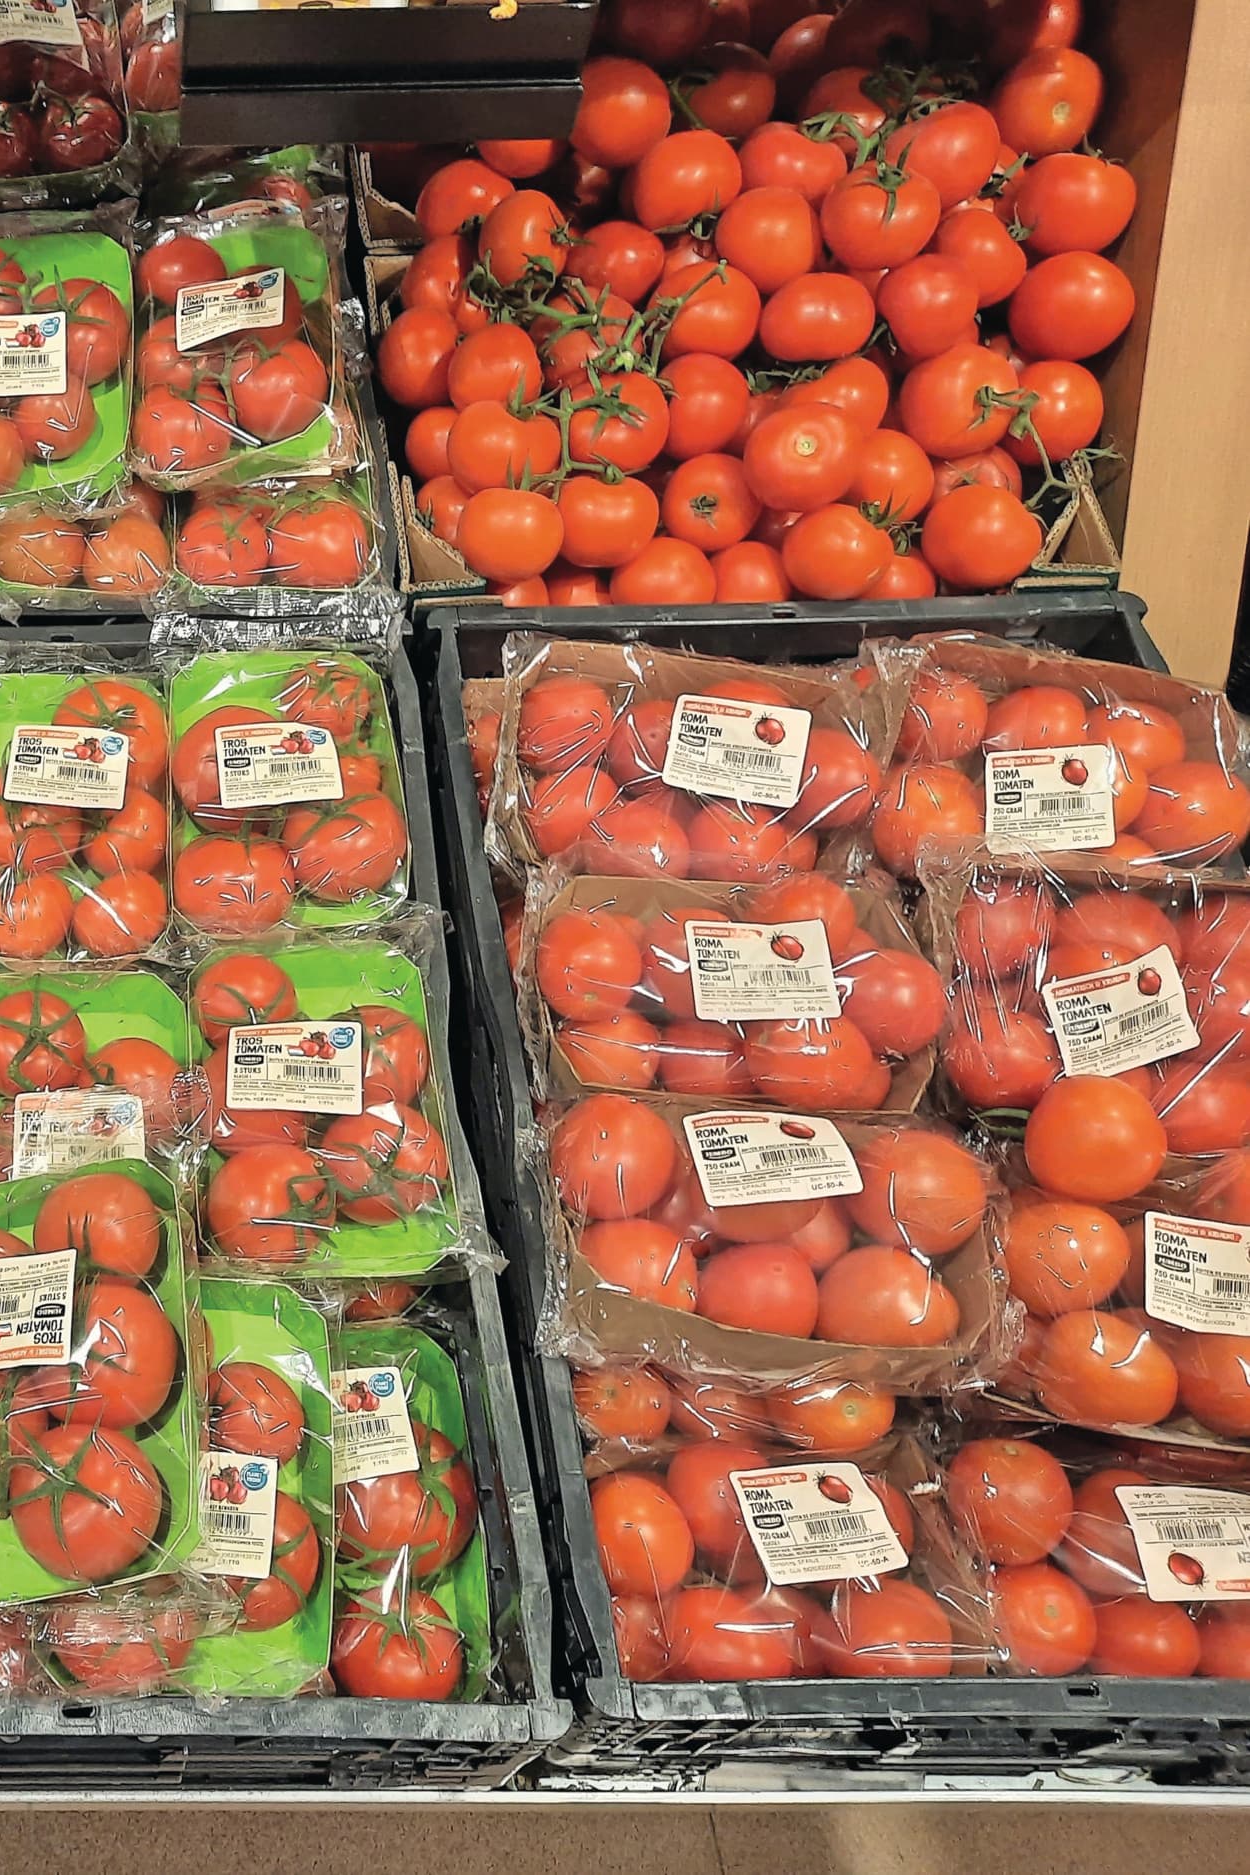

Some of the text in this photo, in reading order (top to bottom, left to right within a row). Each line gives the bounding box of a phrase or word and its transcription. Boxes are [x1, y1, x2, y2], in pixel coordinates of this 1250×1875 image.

[680, 712, 709, 725] ROMA
[679, 723, 722, 738] TOMATEN
[18, 737, 41, 746] TROS
[223, 738, 247, 748] TROS
[993, 769, 1020, 779] ROMA
[993, 779, 1034, 790] TOMATEN
[694, 937, 723, 949] ROMA
[696, 948, 741, 960] TOMATEN
[1055, 995, 1090, 1011] ROMA
[1058, 1002, 1112, 1023] TOMATEN
[235, 1036, 262, 1045] TROS
[695, 1127, 729, 1139] ROMA
[698, 1134, 749, 1149] TOMATEN
[1154, 1230, 1188, 1247] ROMA
[1154, 1243, 1207, 1263] TOMATEN
[1154, 1268, 1191, 1285] 750 GRAM
[16, 1319, 64, 1334] TOMATEN
[33, 1333, 63, 1344] TROS
[743, 1489, 773, 1502] ROMA
[748, 1499, 794, 1514] TOMATEN
